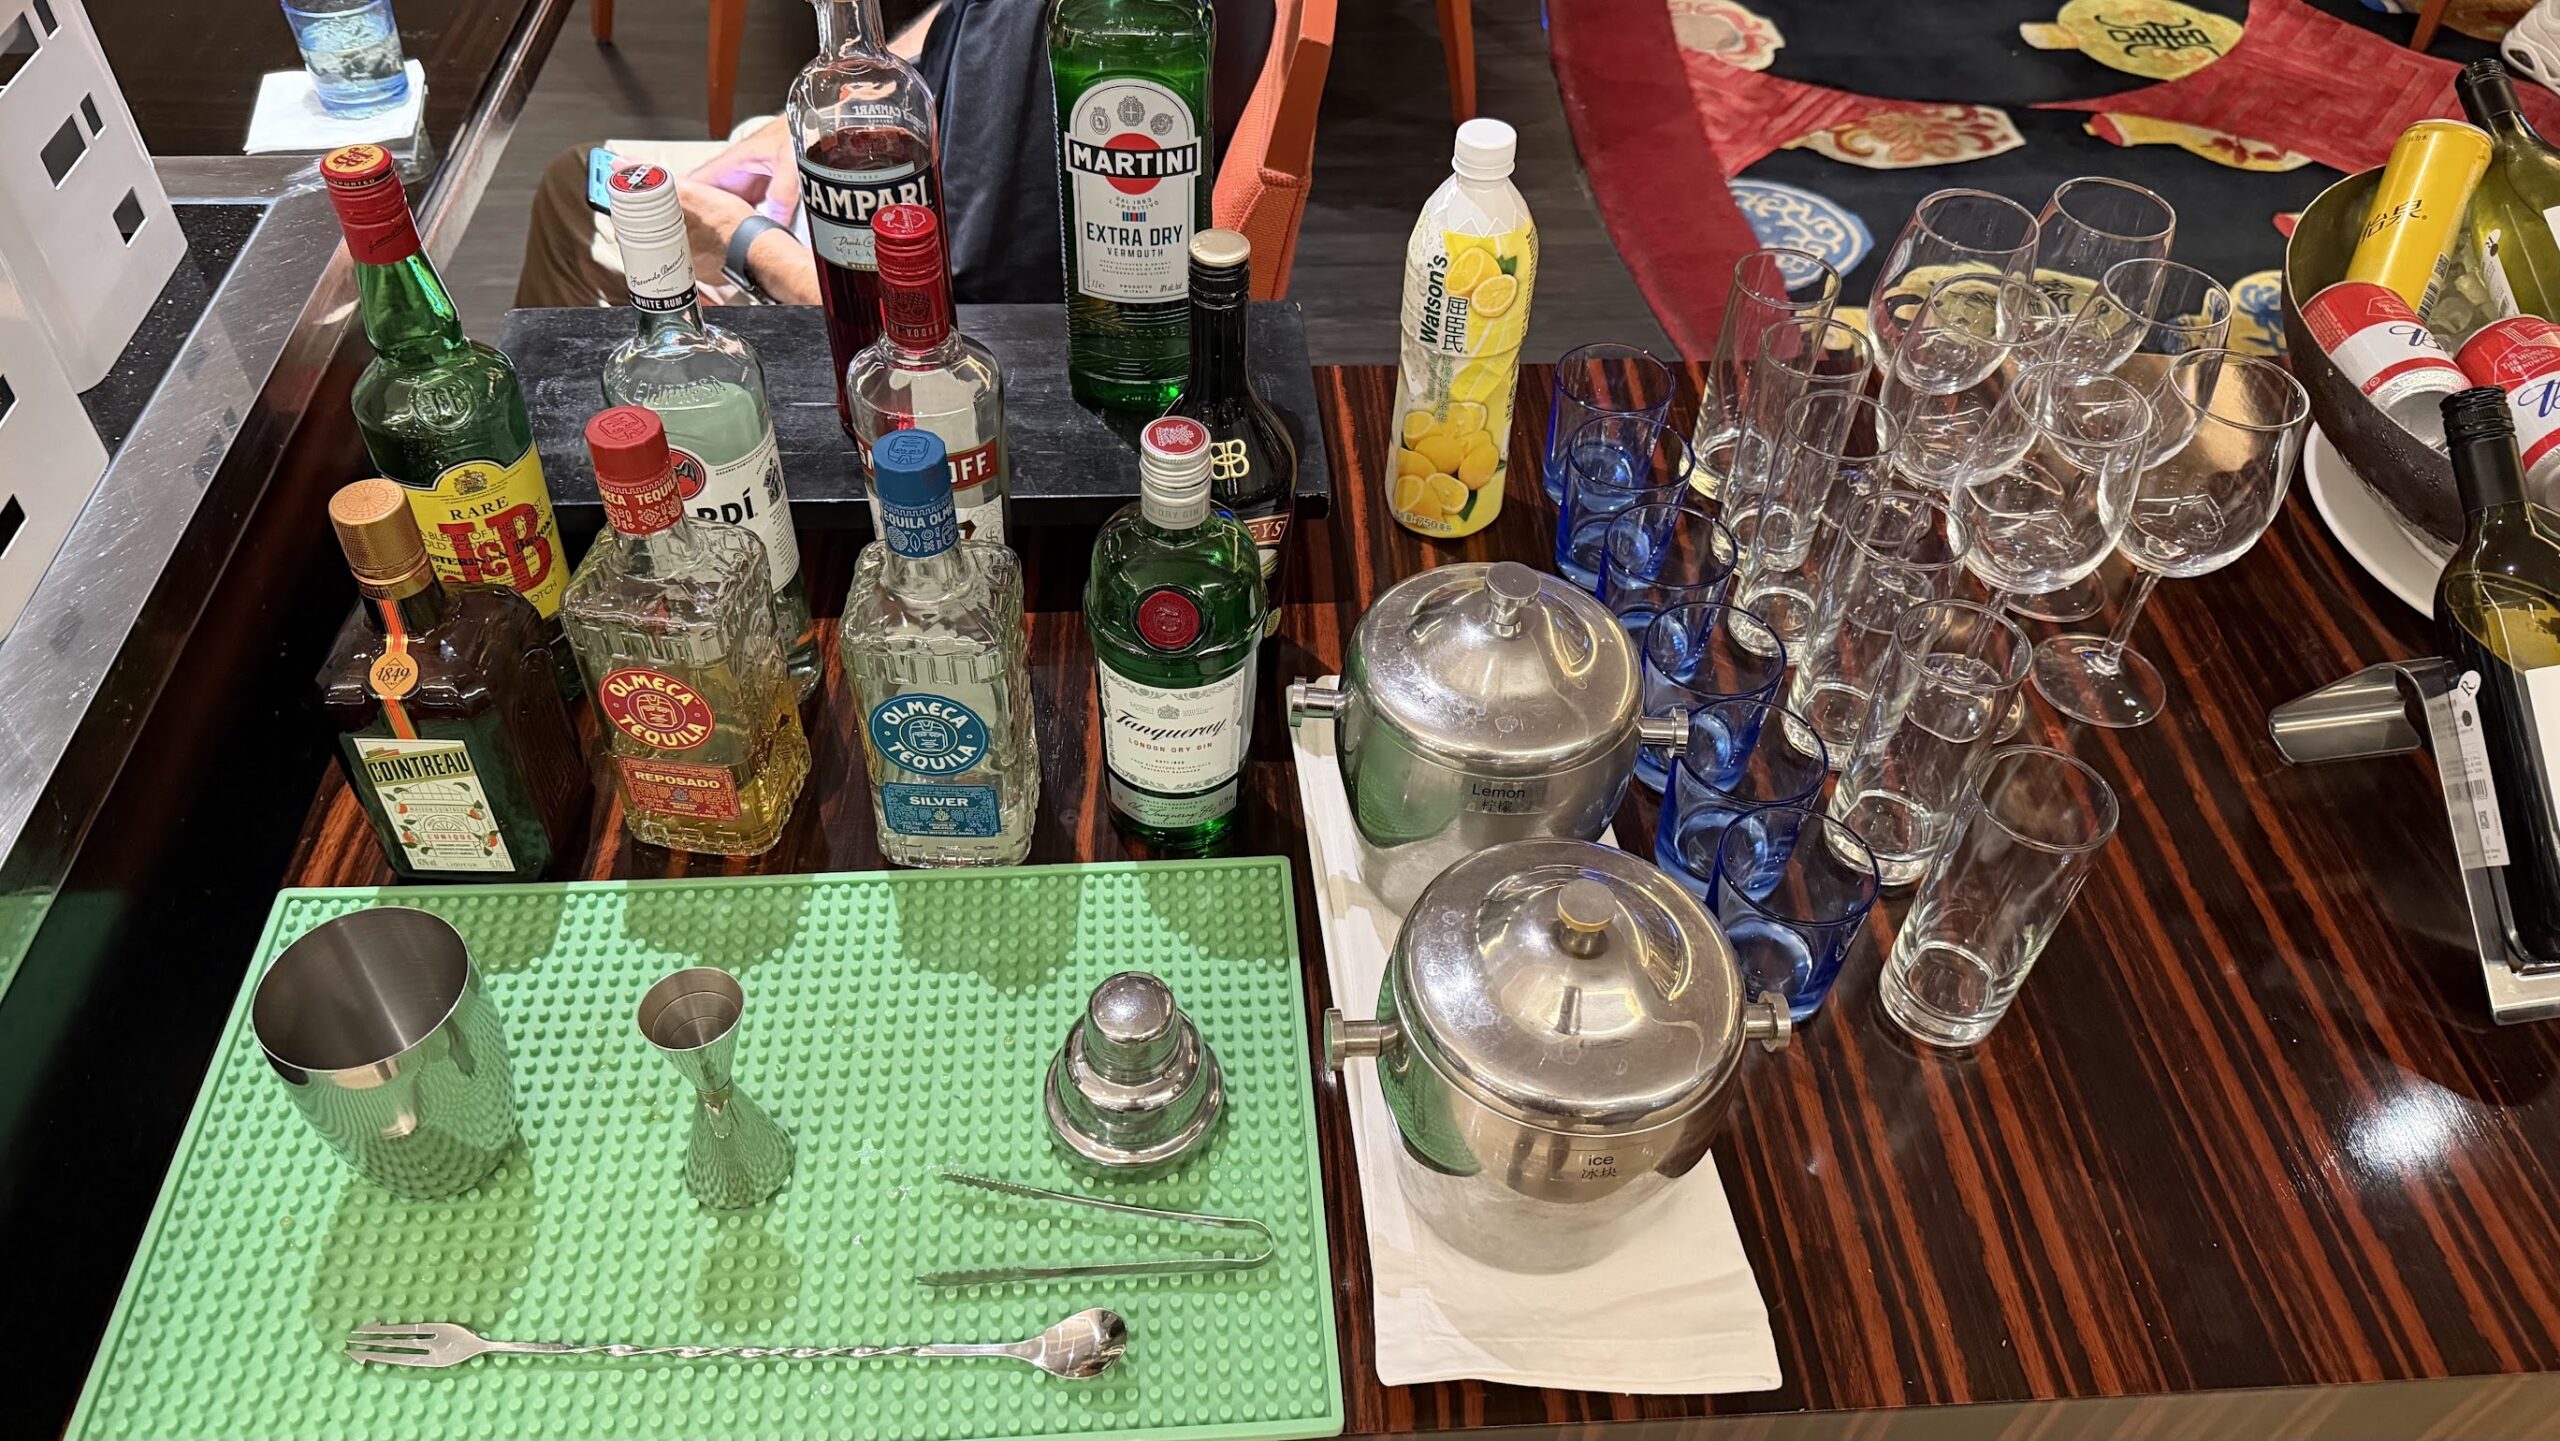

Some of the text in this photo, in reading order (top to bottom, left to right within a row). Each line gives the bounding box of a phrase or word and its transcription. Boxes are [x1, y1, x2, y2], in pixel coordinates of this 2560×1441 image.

[1073, 143, 1193, 176] MARTINI
[1087, 222, 1183, 247] EXTRA DRY
[1107, 248, 1164, 258] VERMOUTH
[635, 296, 683, 310] WHITE RUM
[1419, 254, 1448, 345] Watson's
[449, 496, 509, 521] RARE
[437, 503, 552, 593] J&B
[376, 666, 410, 682] 1849
[608, 674, 694, 706] OLMECA
[882, 701, 969, 730] OLMECA
[1116, 708, 1227, 741] Tanqueray
[619, 714, 708, 747] TEQUILA
[887, 741, 978, 771] TEQUILA
[1128, 737, 1214, 753] LONDON DRY GIN
[367, 751, 471, 783] COINTREAU
[634, 771, 721, 789] REPOSADO
[1472, 784, 1526, 799] Lemon
[909, 796, 969, 807] SILVER
[1581, 1166, 1617, 1179] 冰块
[1588, 1154, 1614, 1166] ice
